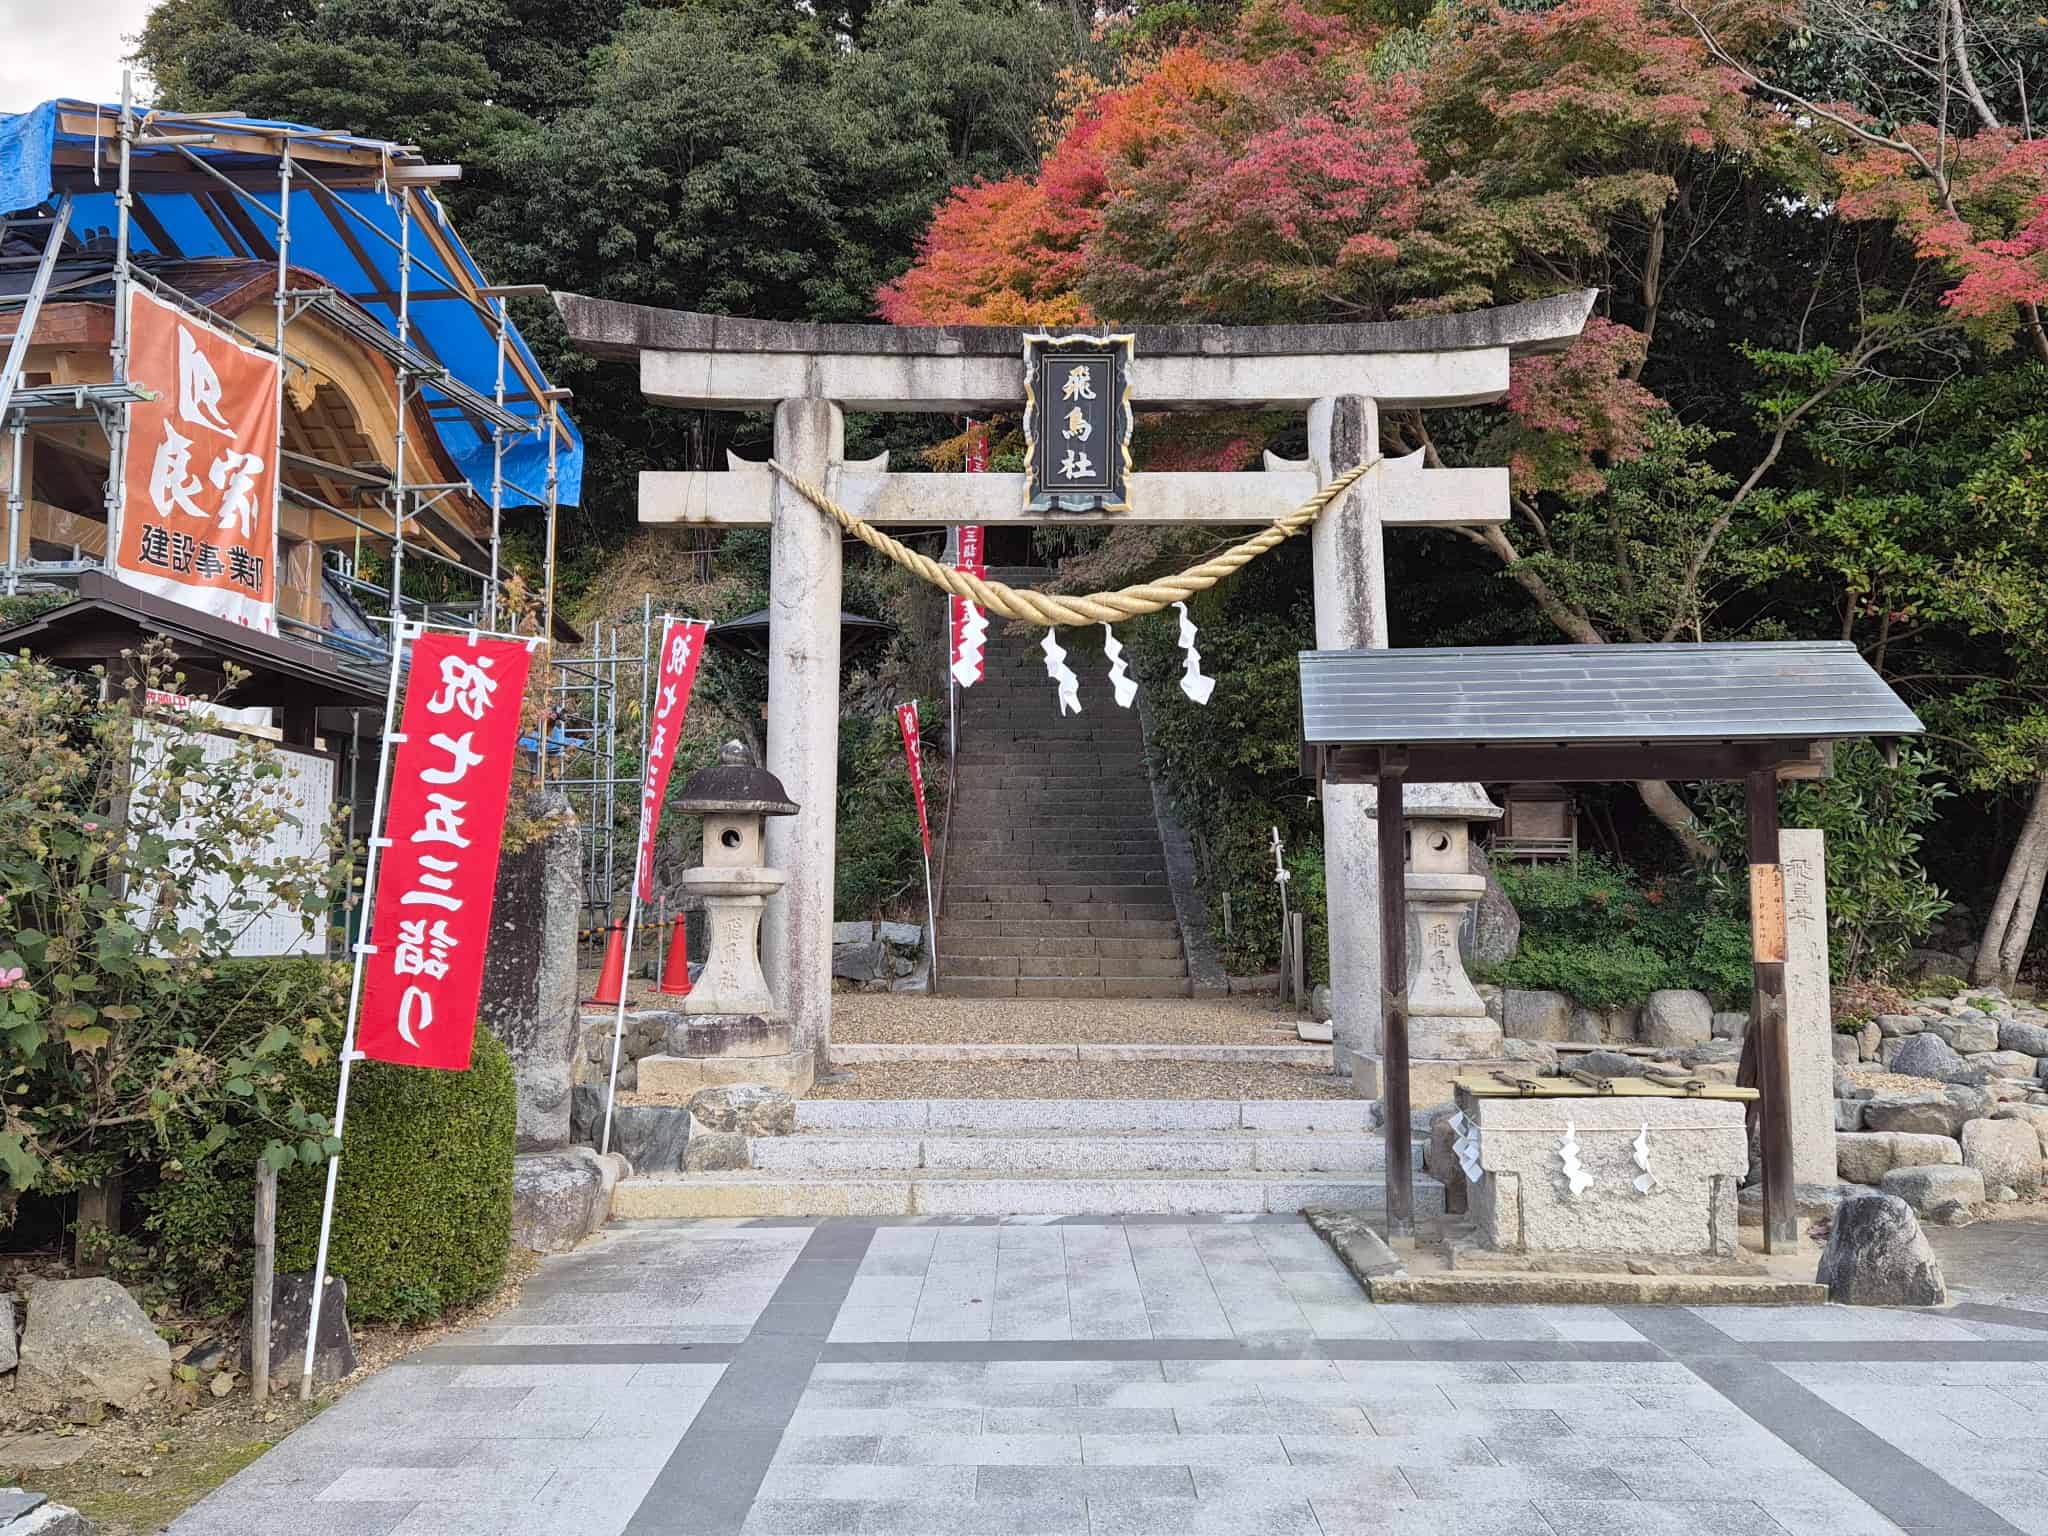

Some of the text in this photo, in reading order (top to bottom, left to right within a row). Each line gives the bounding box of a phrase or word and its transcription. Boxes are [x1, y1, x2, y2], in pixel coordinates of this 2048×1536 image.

[1057, 365, 1097, 480] 飛鳥社
[138, 523, 264, 593] 建設事業部
[393, 655, 499, 1048] 祝七五三詣り
[640, 634, 693, 889] 祝七五三詣り
